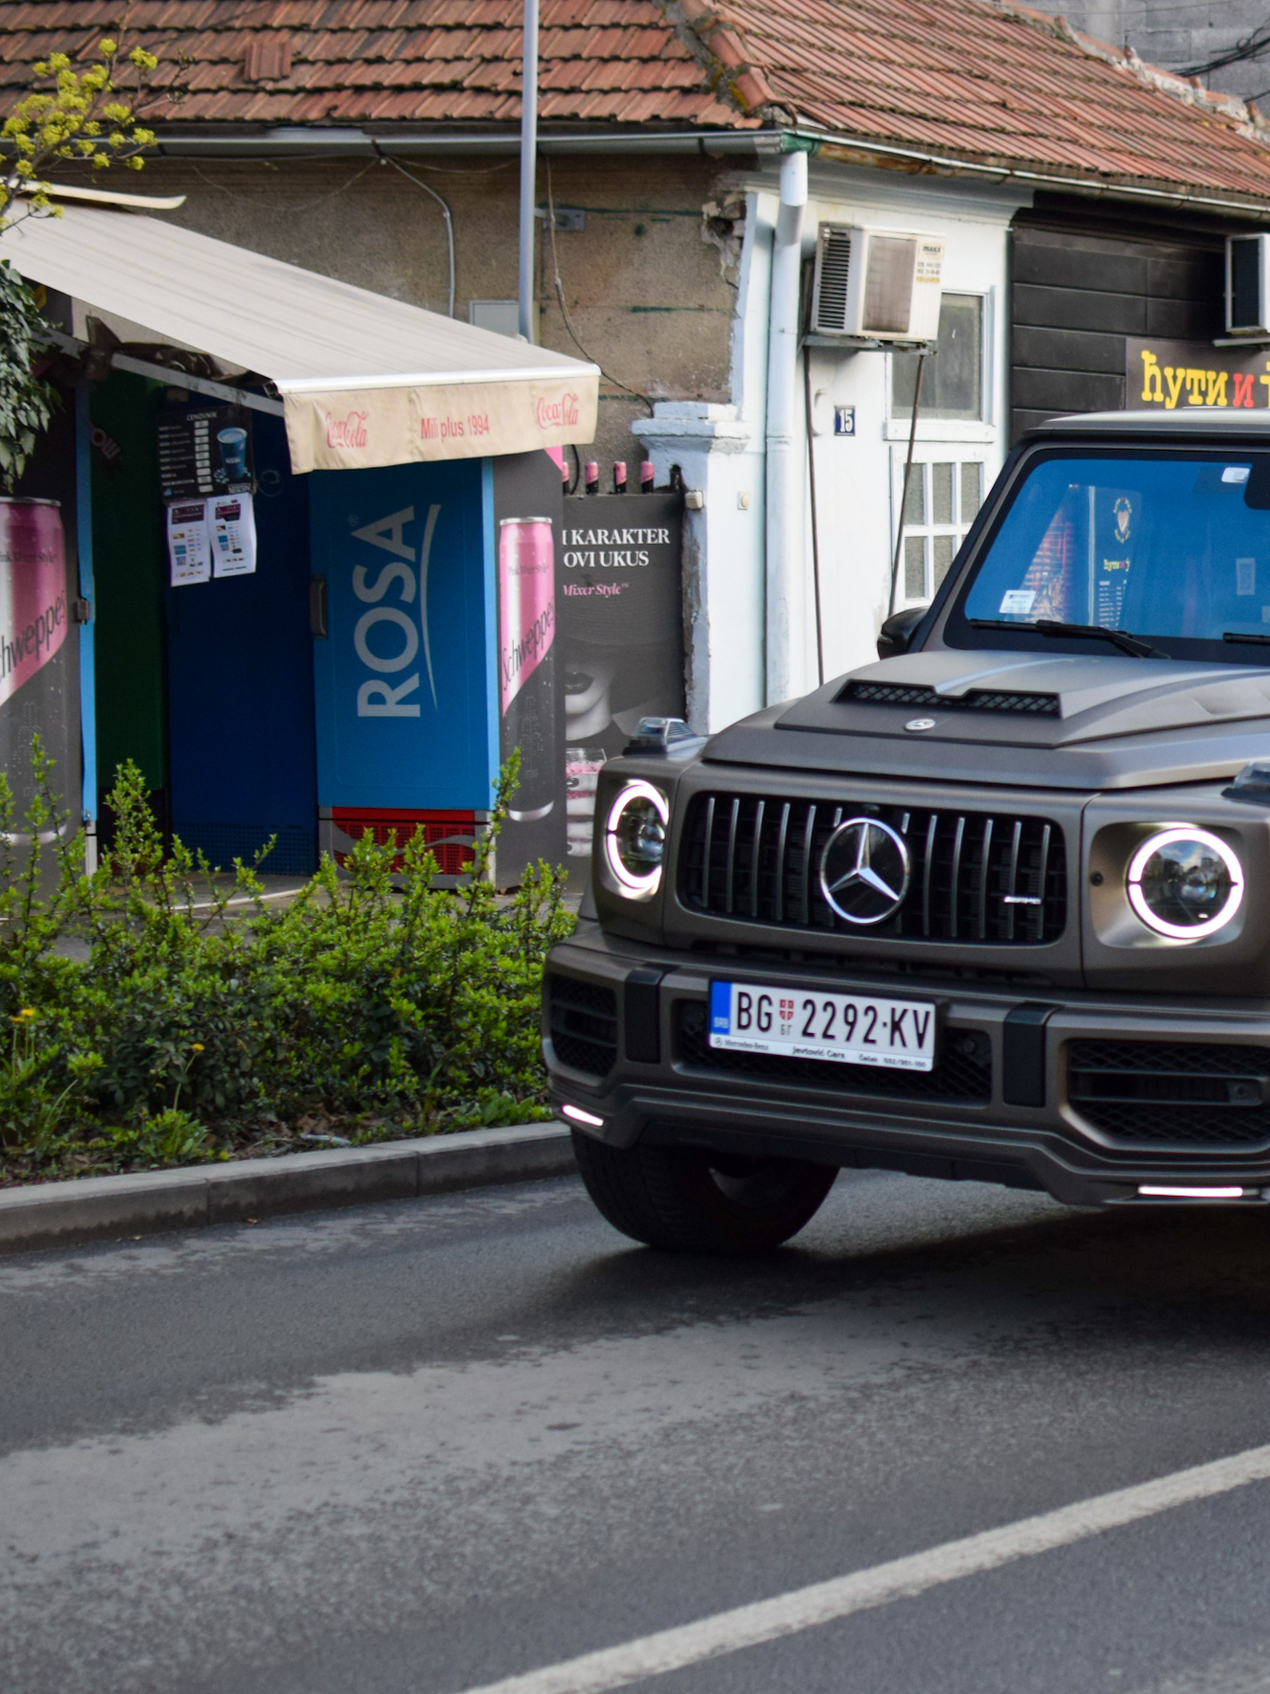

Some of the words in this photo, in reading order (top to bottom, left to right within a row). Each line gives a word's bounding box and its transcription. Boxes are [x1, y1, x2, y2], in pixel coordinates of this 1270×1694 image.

[1141, 350, 1229, 409] ћути
[1233, 373, 1255, 408] и
[326, 411, 368, 449] Coca-Cola
[421, 418, 438, 440] Mili
[441, 416, 464, 442] plus
[467, 414, 490, 435] 1994
[536, 393, 579, 430] Coca-Cola
[840, 409, 853, 433] 15
[571, 529, 670, 546] KARAKTER
[563, 552, 595, 568] OVI
[600, 551, 650, 567] UKUS
[350, 505, 421, 718] ROSA
[737, 991, 773, 1033] BG
